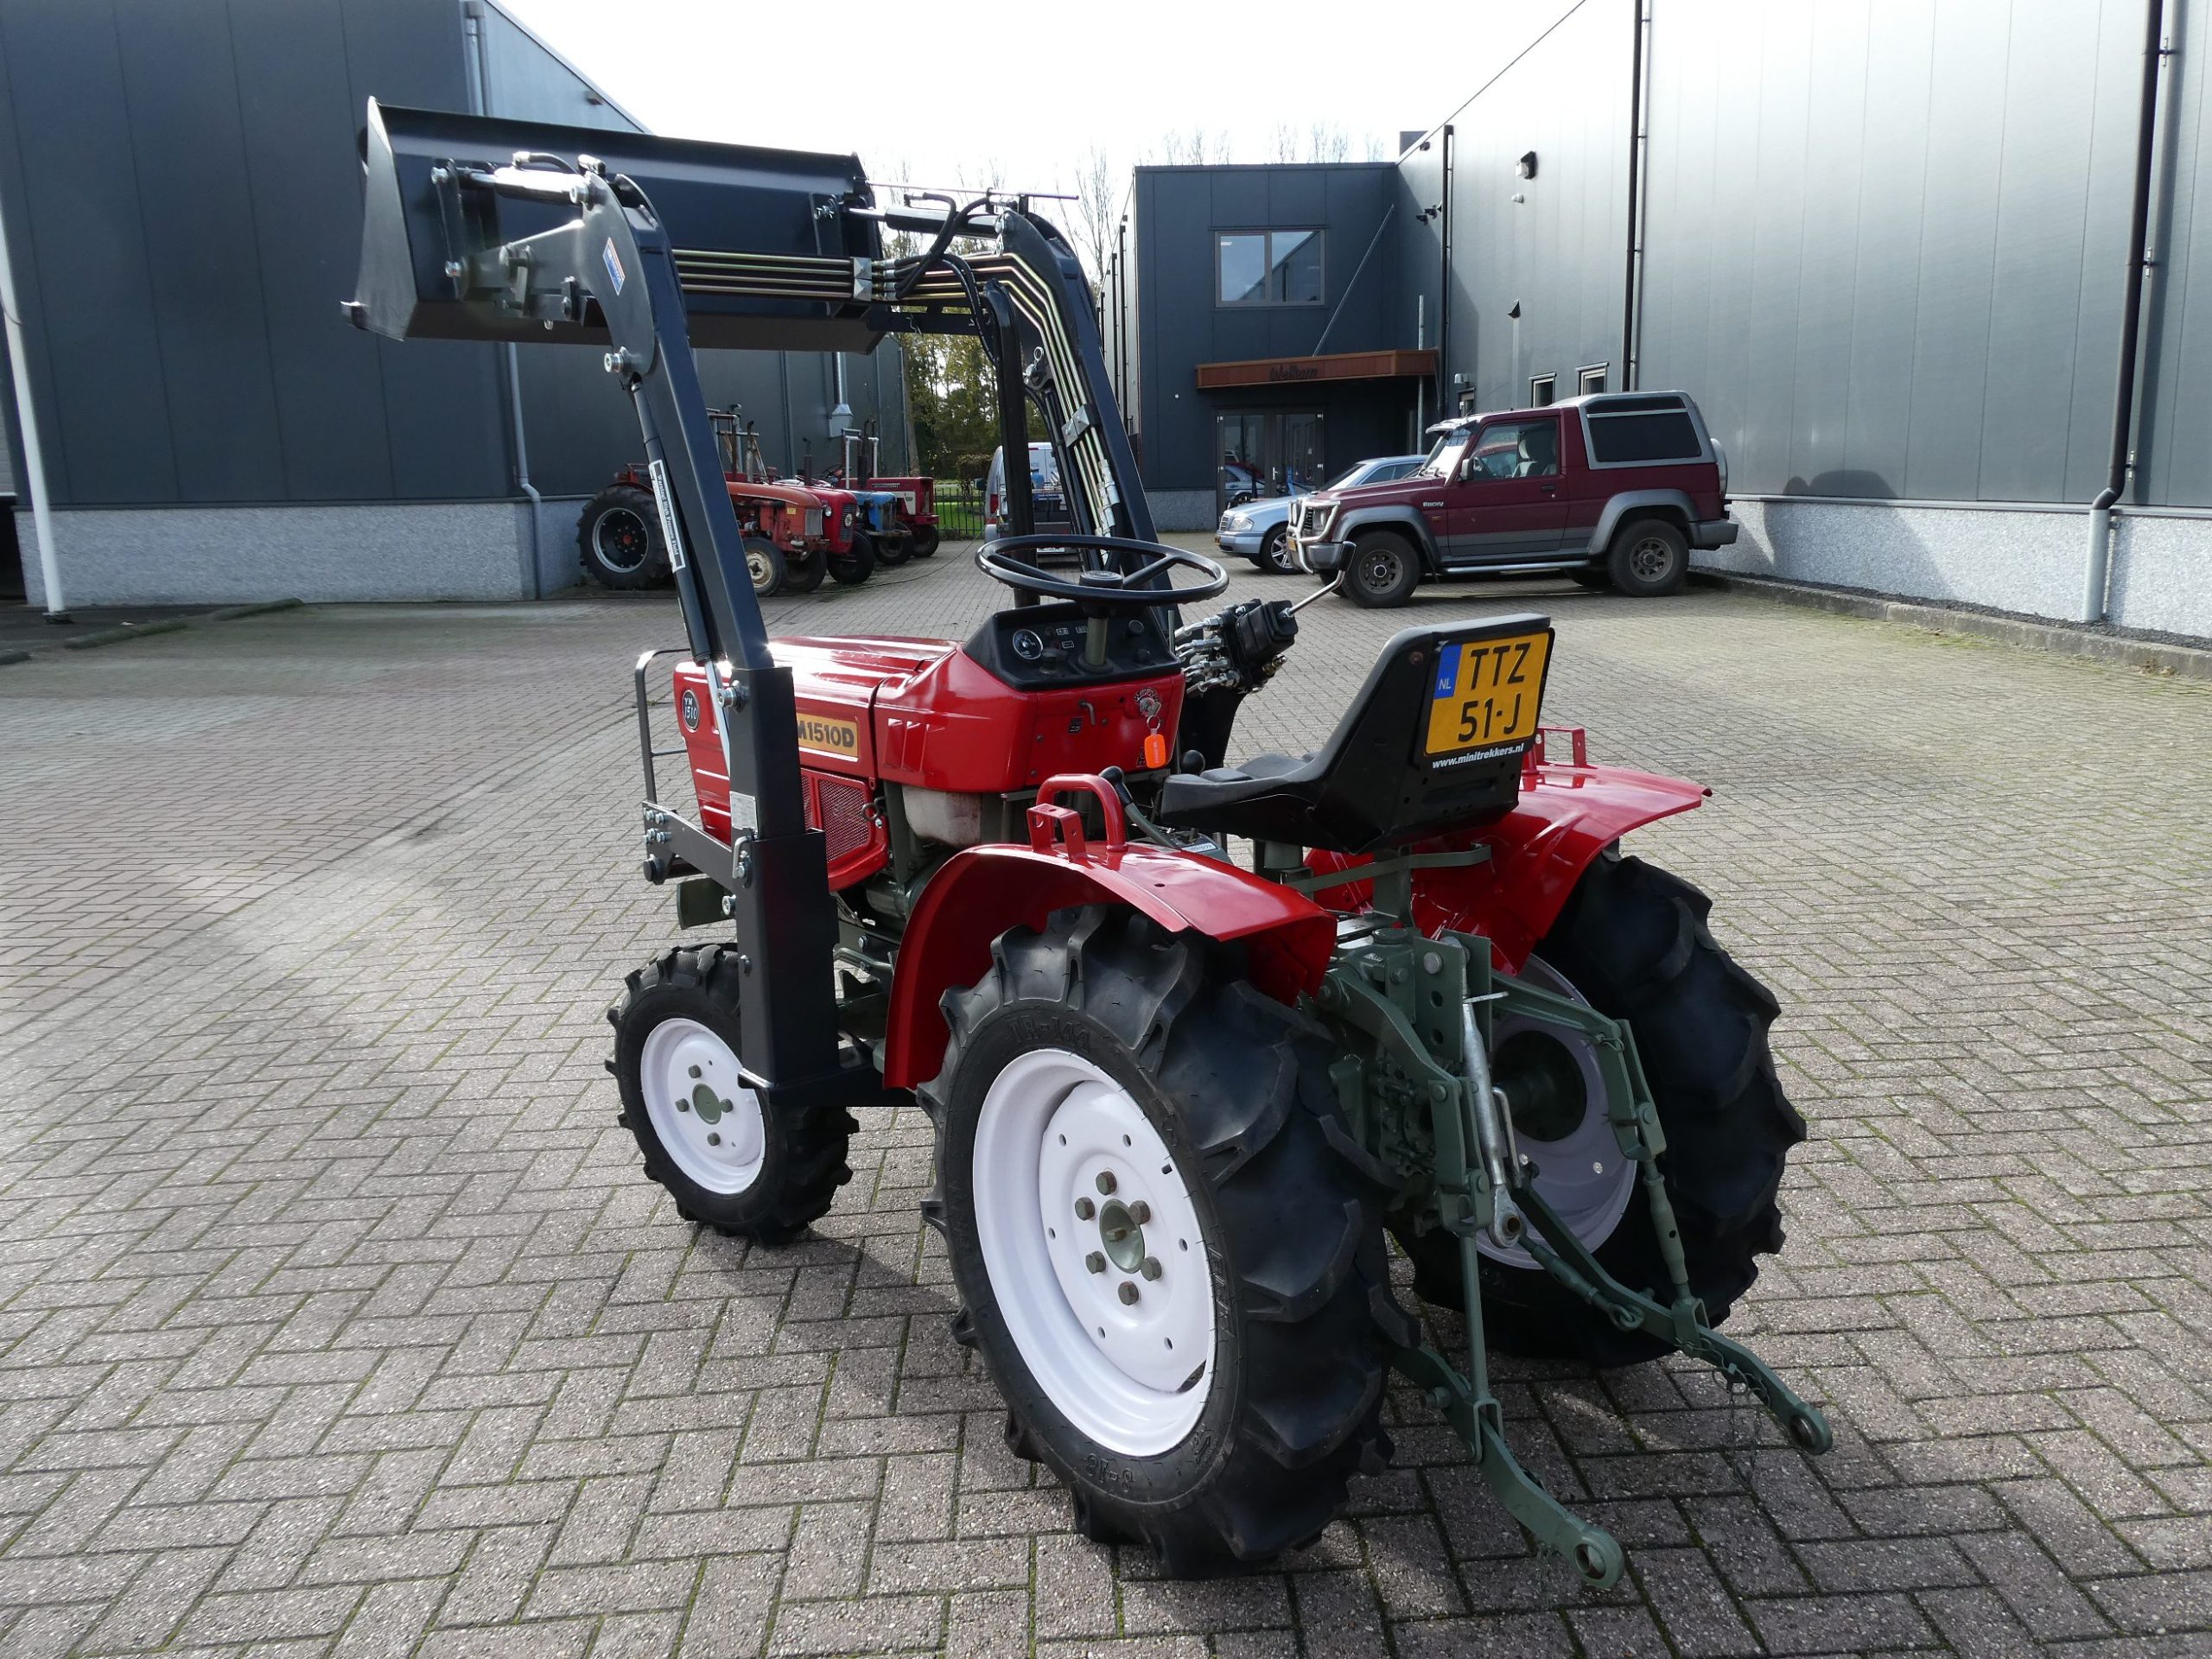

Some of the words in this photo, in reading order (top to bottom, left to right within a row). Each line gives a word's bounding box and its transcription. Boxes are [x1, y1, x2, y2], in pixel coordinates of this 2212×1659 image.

[1470, 642, 1532, 690] TTZ
[1439, 677, 1452, 690] NL
[684, 705, 697, 720] 1510
[1432, 742, 1525, 769] www.minitrekkers.nl
